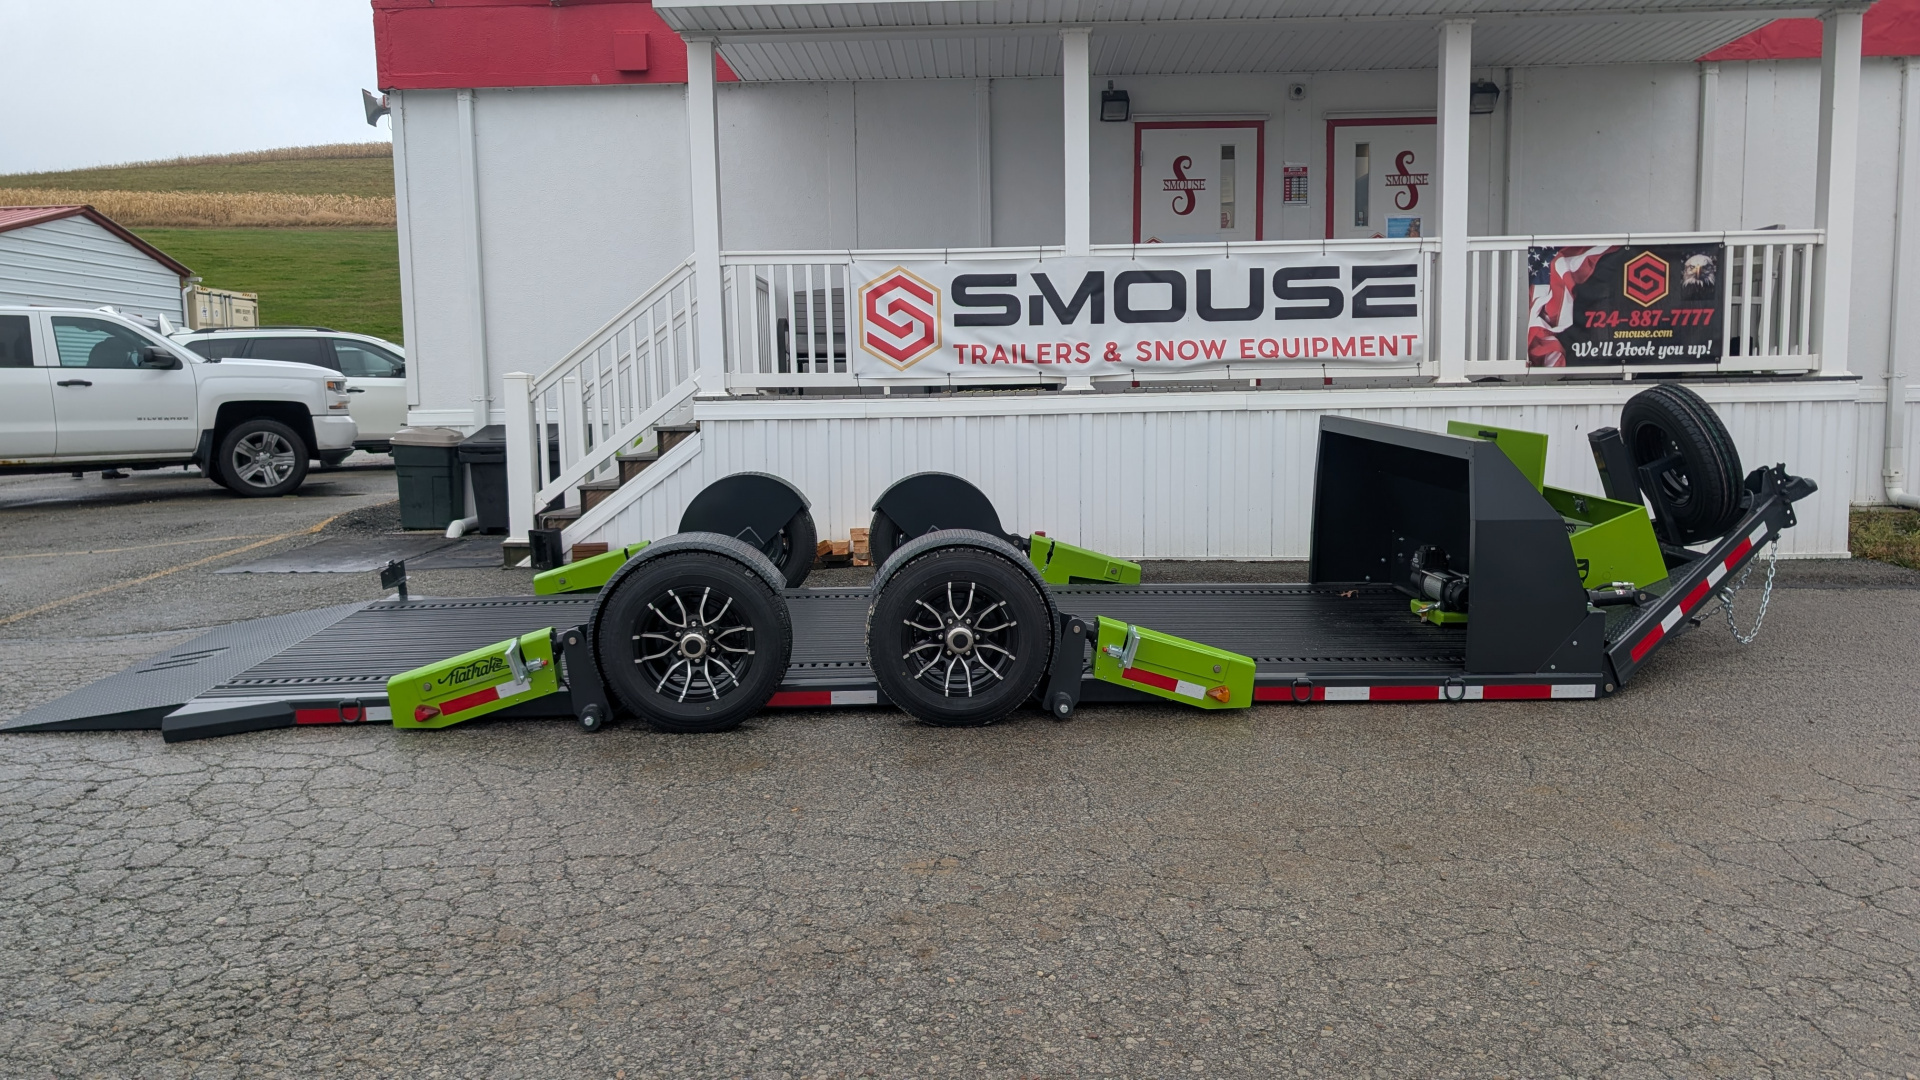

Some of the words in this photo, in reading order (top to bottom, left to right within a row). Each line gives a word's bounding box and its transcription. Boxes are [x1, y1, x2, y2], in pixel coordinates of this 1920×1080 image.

[1163, 179, 1206, 191] SMOUSE
[1385, 174, 1428, 186] SMOUSE
[950, 263, 1418, 327] SMOUSE
[1584, 308, 1715, 328] 724-887-7777
[1613, 329, 1674, 339] smouse.com
[953, 342, 1091, 365] TRAILERS
[1103, 341, 1121, 362] &
[1136, 339, 1227, 362] SNOW
[1239, 334, 1418, 359] EQUIPMENT
[1571, 341, 1614, 357] We'll
[1615, 340, 1656, 357] Hook
[1658, 345, 1684, 360] you
[1687, 340, 1713, 359] up!
